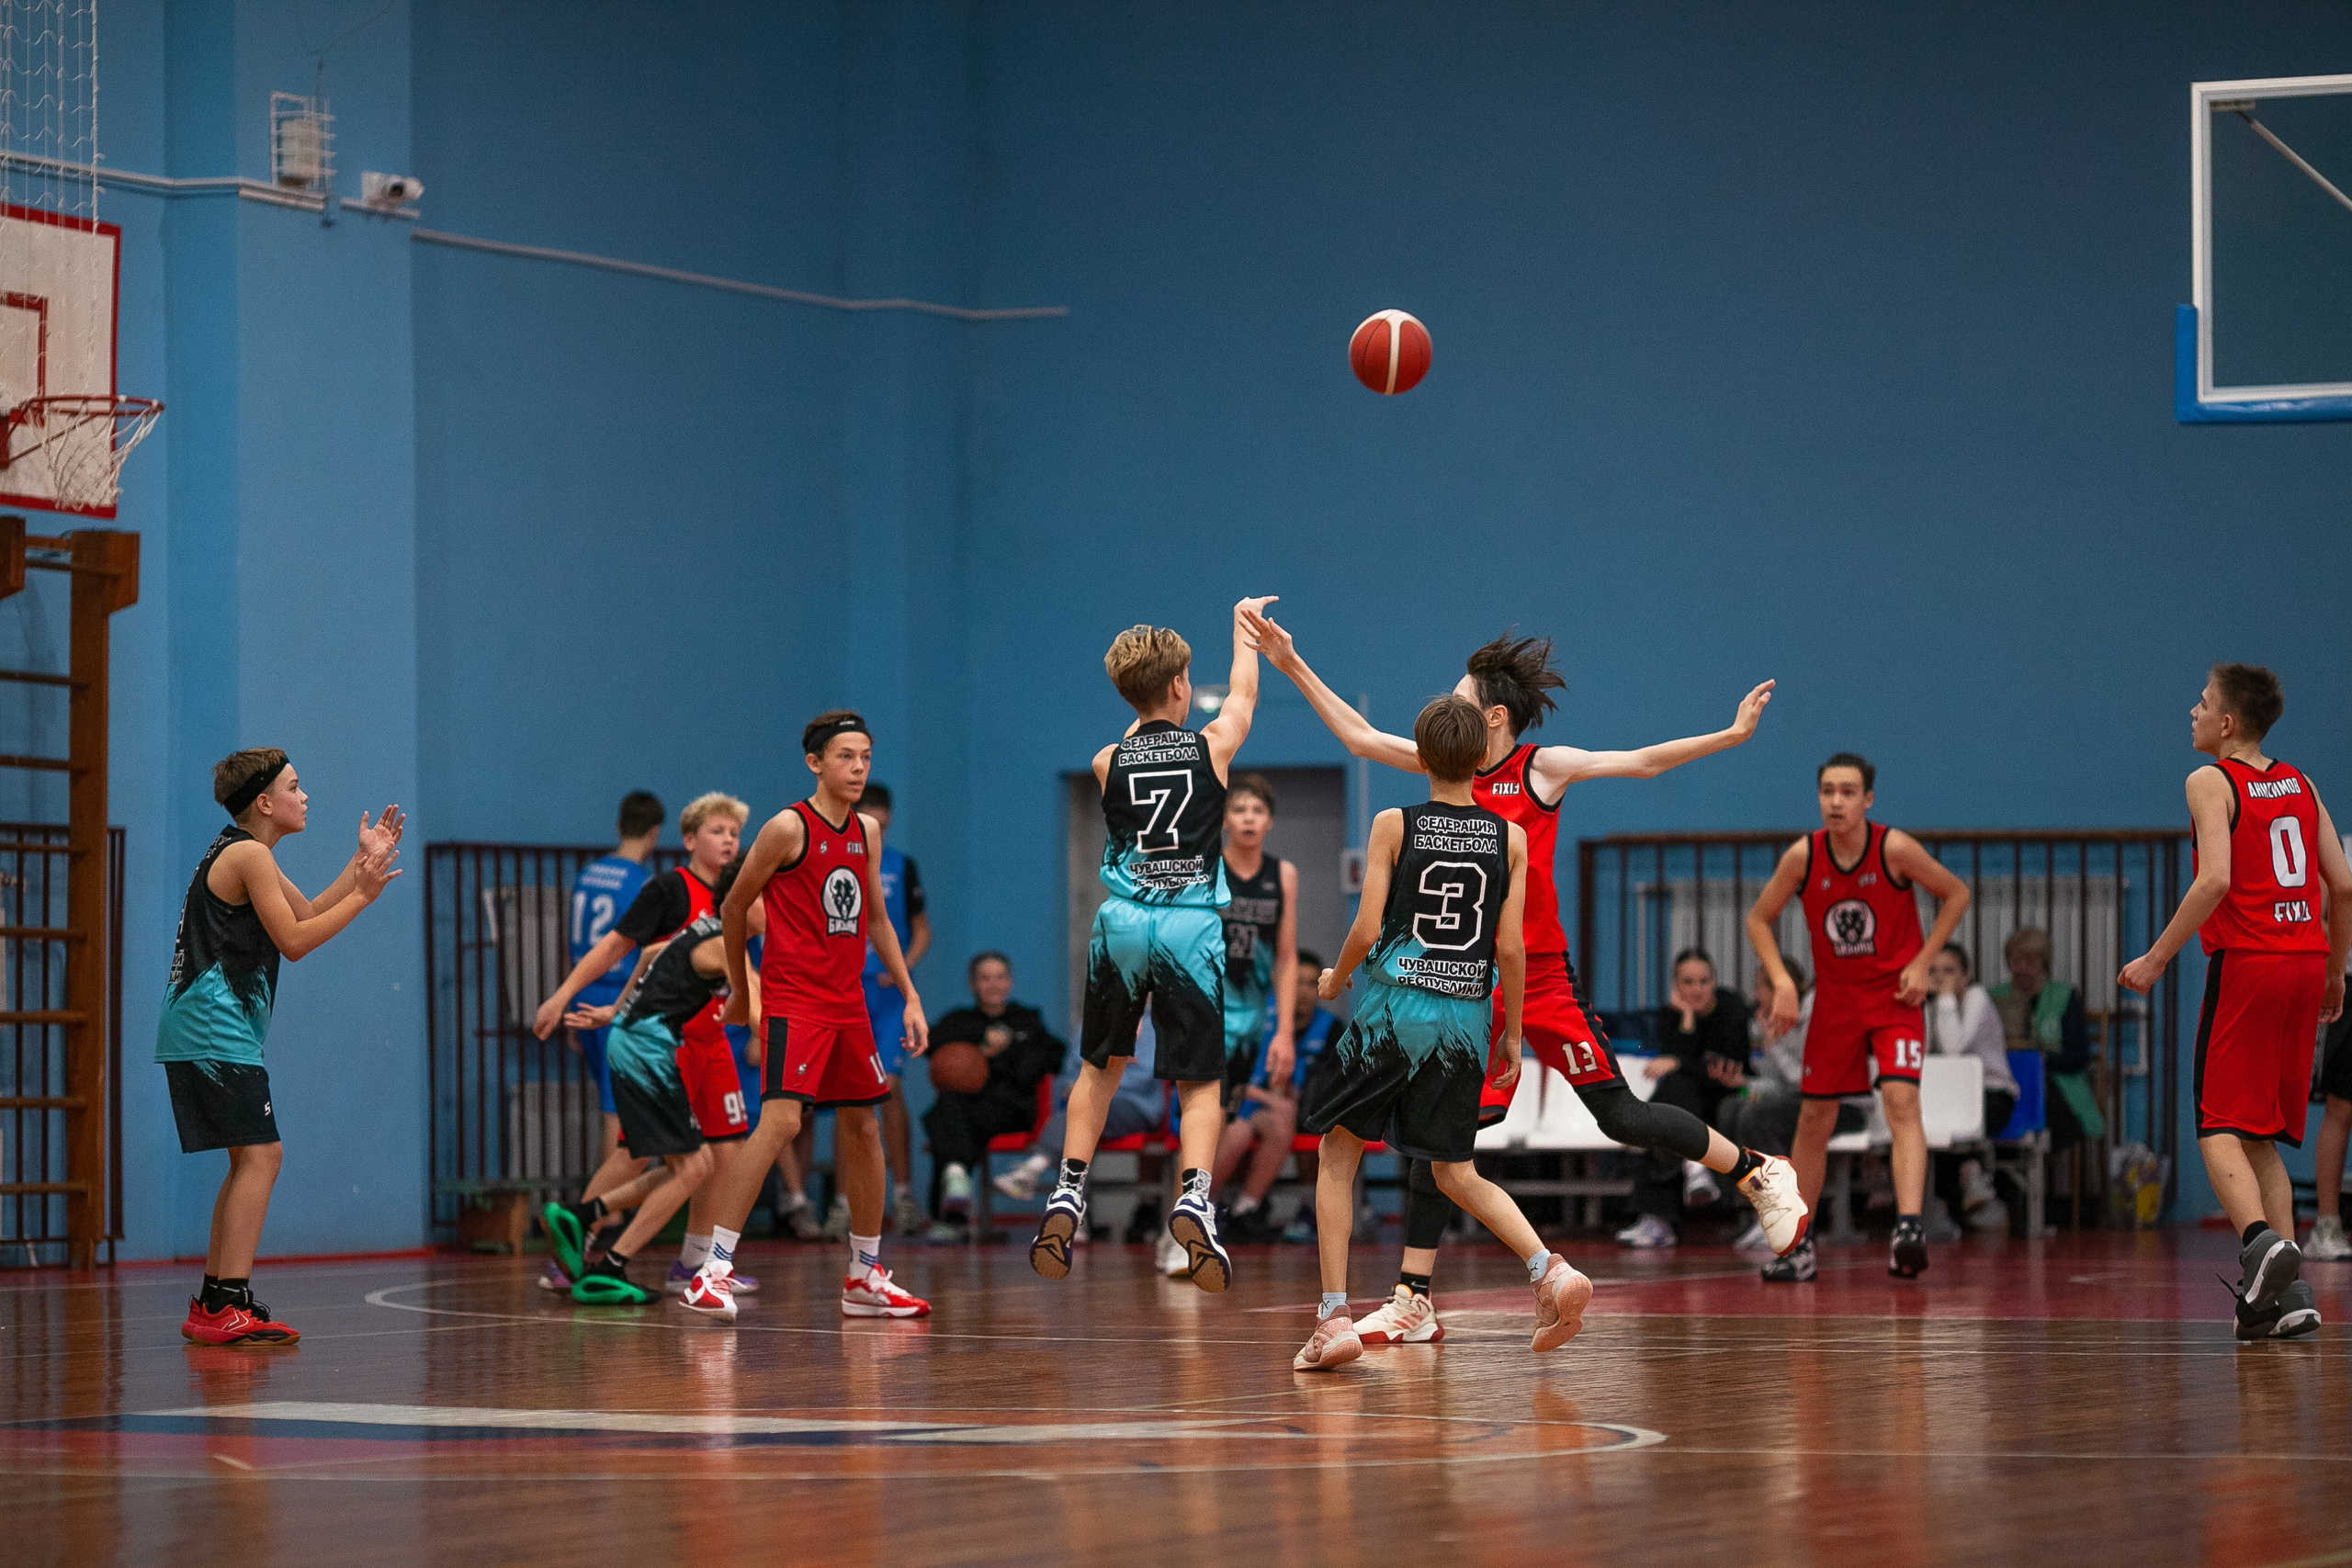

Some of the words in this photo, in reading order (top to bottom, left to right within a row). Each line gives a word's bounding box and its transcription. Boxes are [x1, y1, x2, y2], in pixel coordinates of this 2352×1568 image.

[1121, 731, 1195, 750] ФЕДЕРАЦИЯ
[1119, 747, 1199, 766] БАСКЕТБОЛА
[1128, 770, 1193, 853] 7
[1417, 816, 1498, 835] ФЕДЕРАЦИЯ
[1414, 835, 1498, 854] БАСКЕТБОЛА
[2269, 815, 2307, 887] 0
[1128, 855, 1204, 877] ЧУВАШСКОЙ
[1412, 861, 1487, 951] 3
[572, 891, 615, 946] 12
[1397, 956, 1487, 978] ЧУВАШСКОЙ
[1396, 975, 1484, 997] РЕСПУБЛИКИ
[1562, 1041, 1599, 1075] 13
[1895, 1038, 1922, 1069] 15
